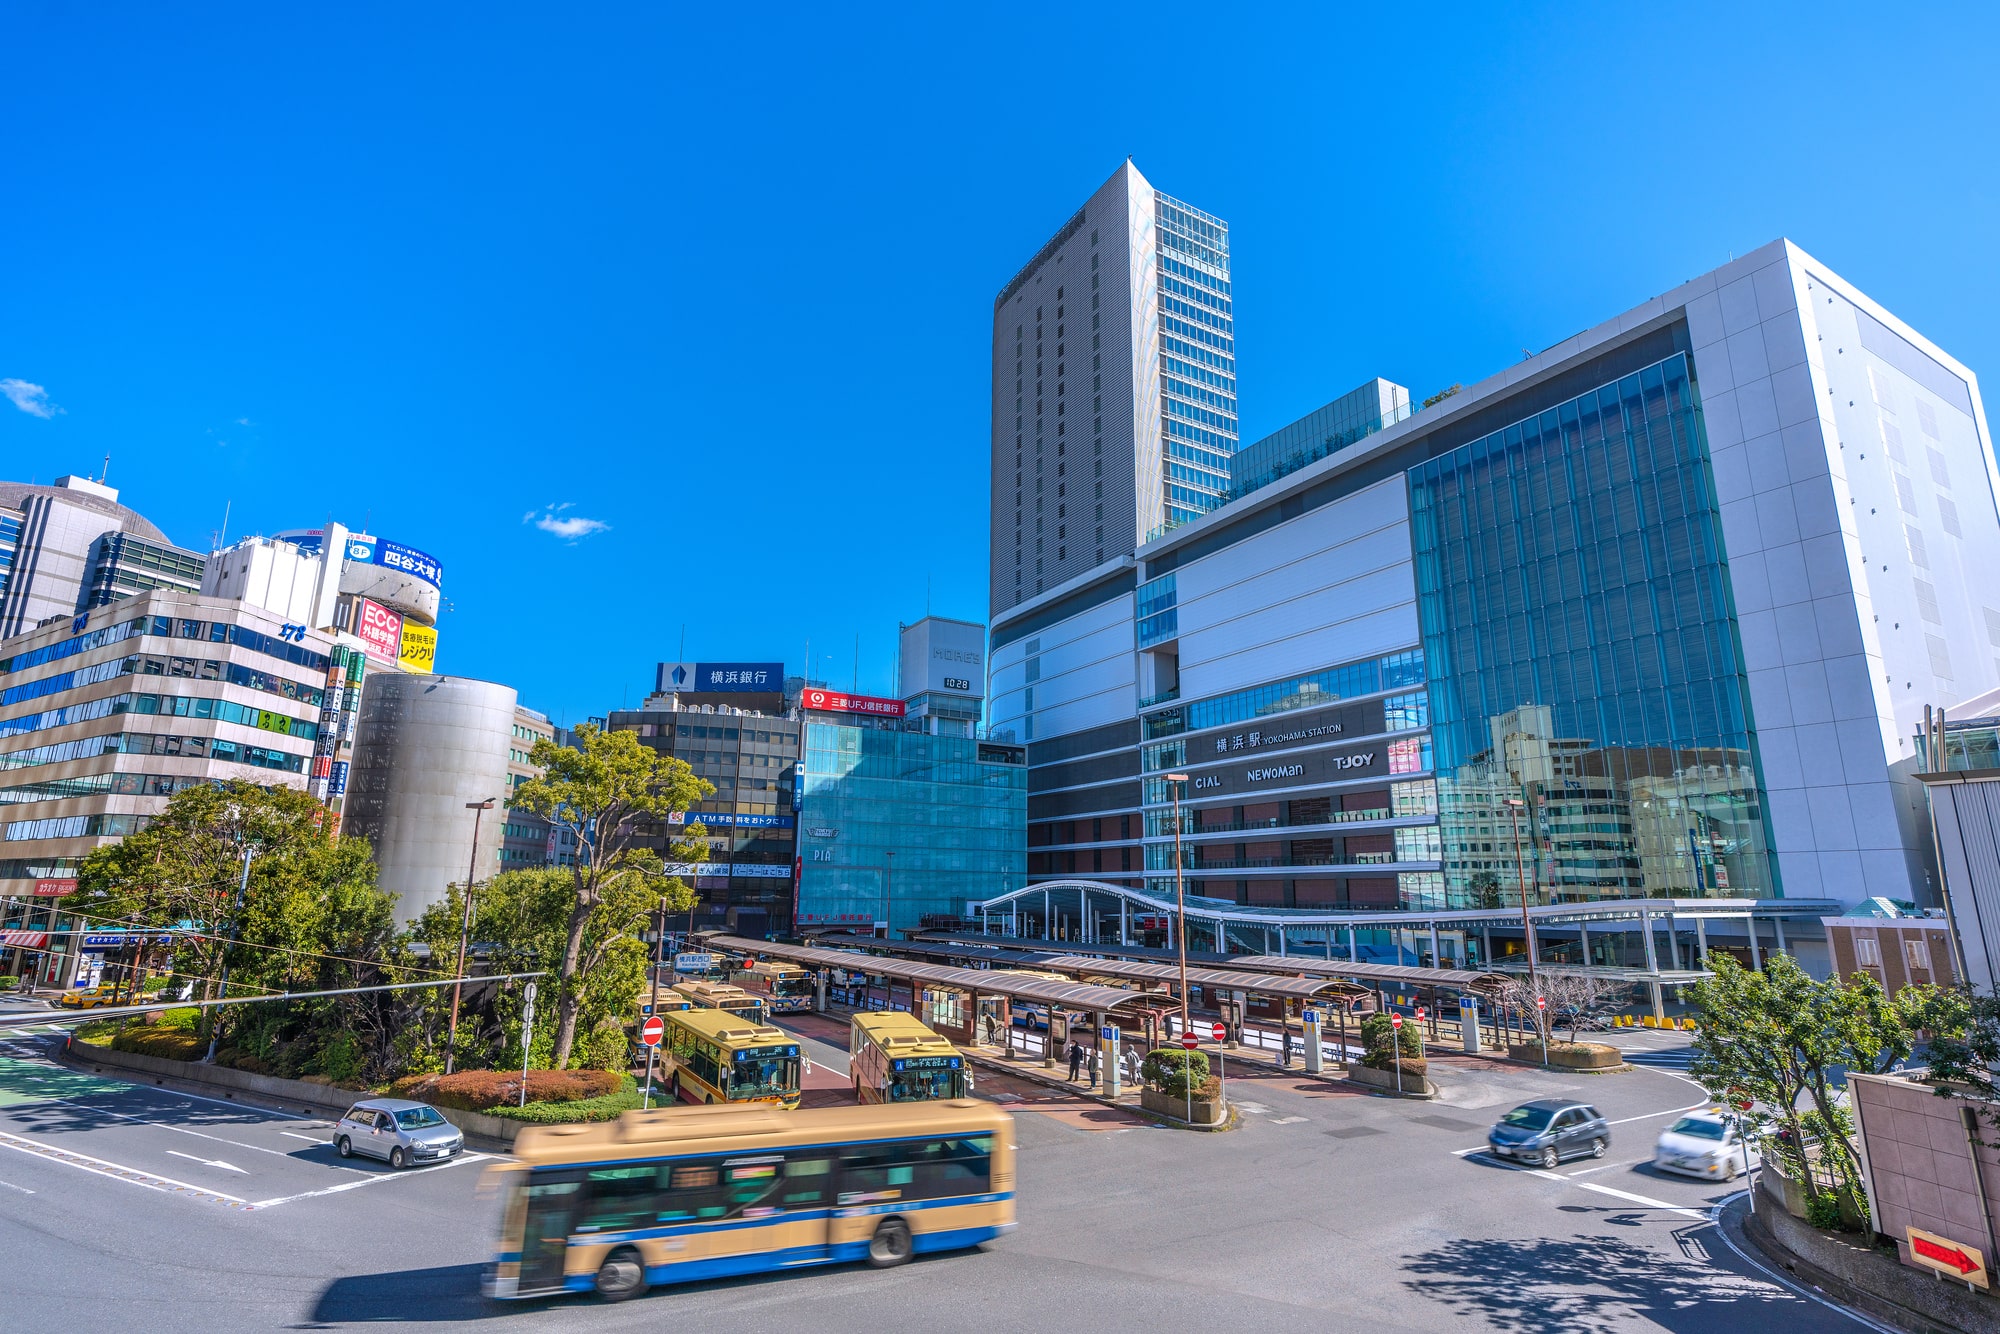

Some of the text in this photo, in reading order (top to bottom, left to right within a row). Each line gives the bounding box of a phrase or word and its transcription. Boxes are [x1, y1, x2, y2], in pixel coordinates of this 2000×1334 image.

[353, 547, 367, 556] 8F
[384, 550, 436, 580] 四谷大塚
[364, 604, 398, 632] ECC
[278, 622, 307, 642] 178
[363, 624, 396, 646] 外語学院
[402, 631, 435, 645] 医療脱毛は
[400, 643, 435, 661] レジクリ
[711, 671, 767, 684] 横浜銀行
[831, 697, 899, 713] 三菱UFJ信託銀行
[1216, 724, 1341, 753] 横浜駅 YOKOHAMA STATION
[1195, 775, 1221, 789] CIAL
[814, 849, 831, 862] PIA
[1306, 1012, 1312, 1022] 6
